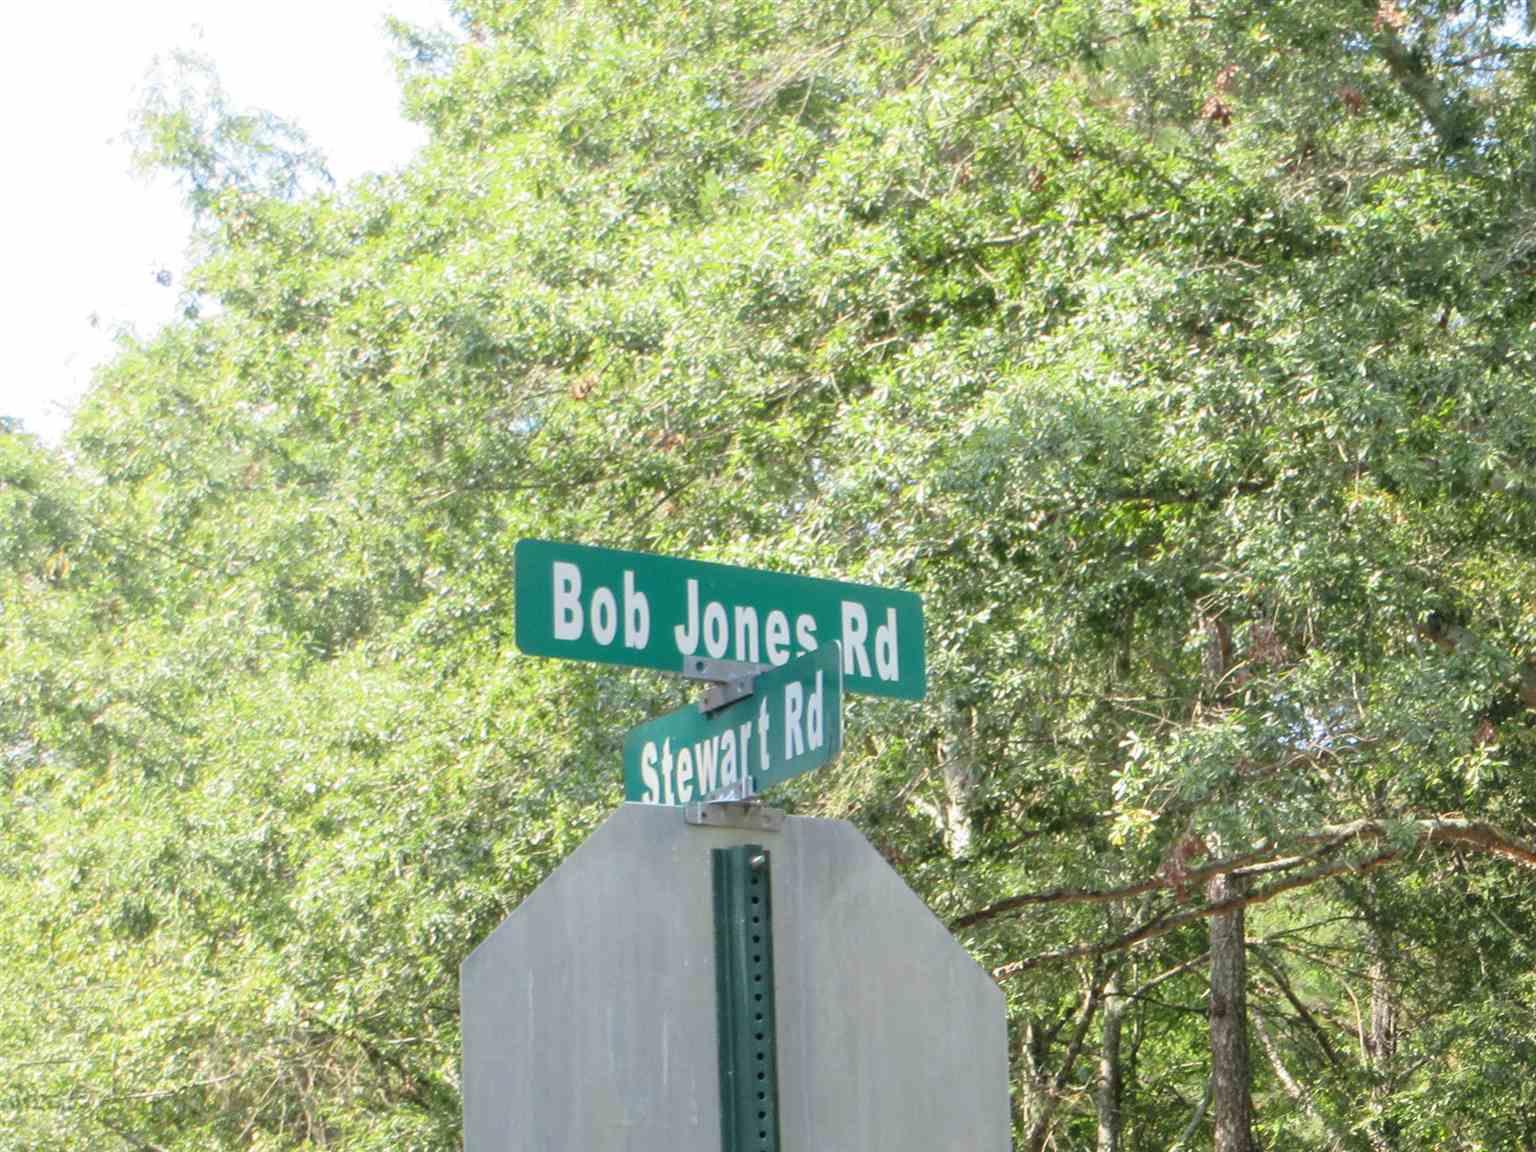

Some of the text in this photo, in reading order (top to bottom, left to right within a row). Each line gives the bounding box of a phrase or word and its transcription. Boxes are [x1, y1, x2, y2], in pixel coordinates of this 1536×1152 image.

[552, 561, 899, 682] Bob Jones Rd
[640, 671, 824, 805] Stewart Rd
